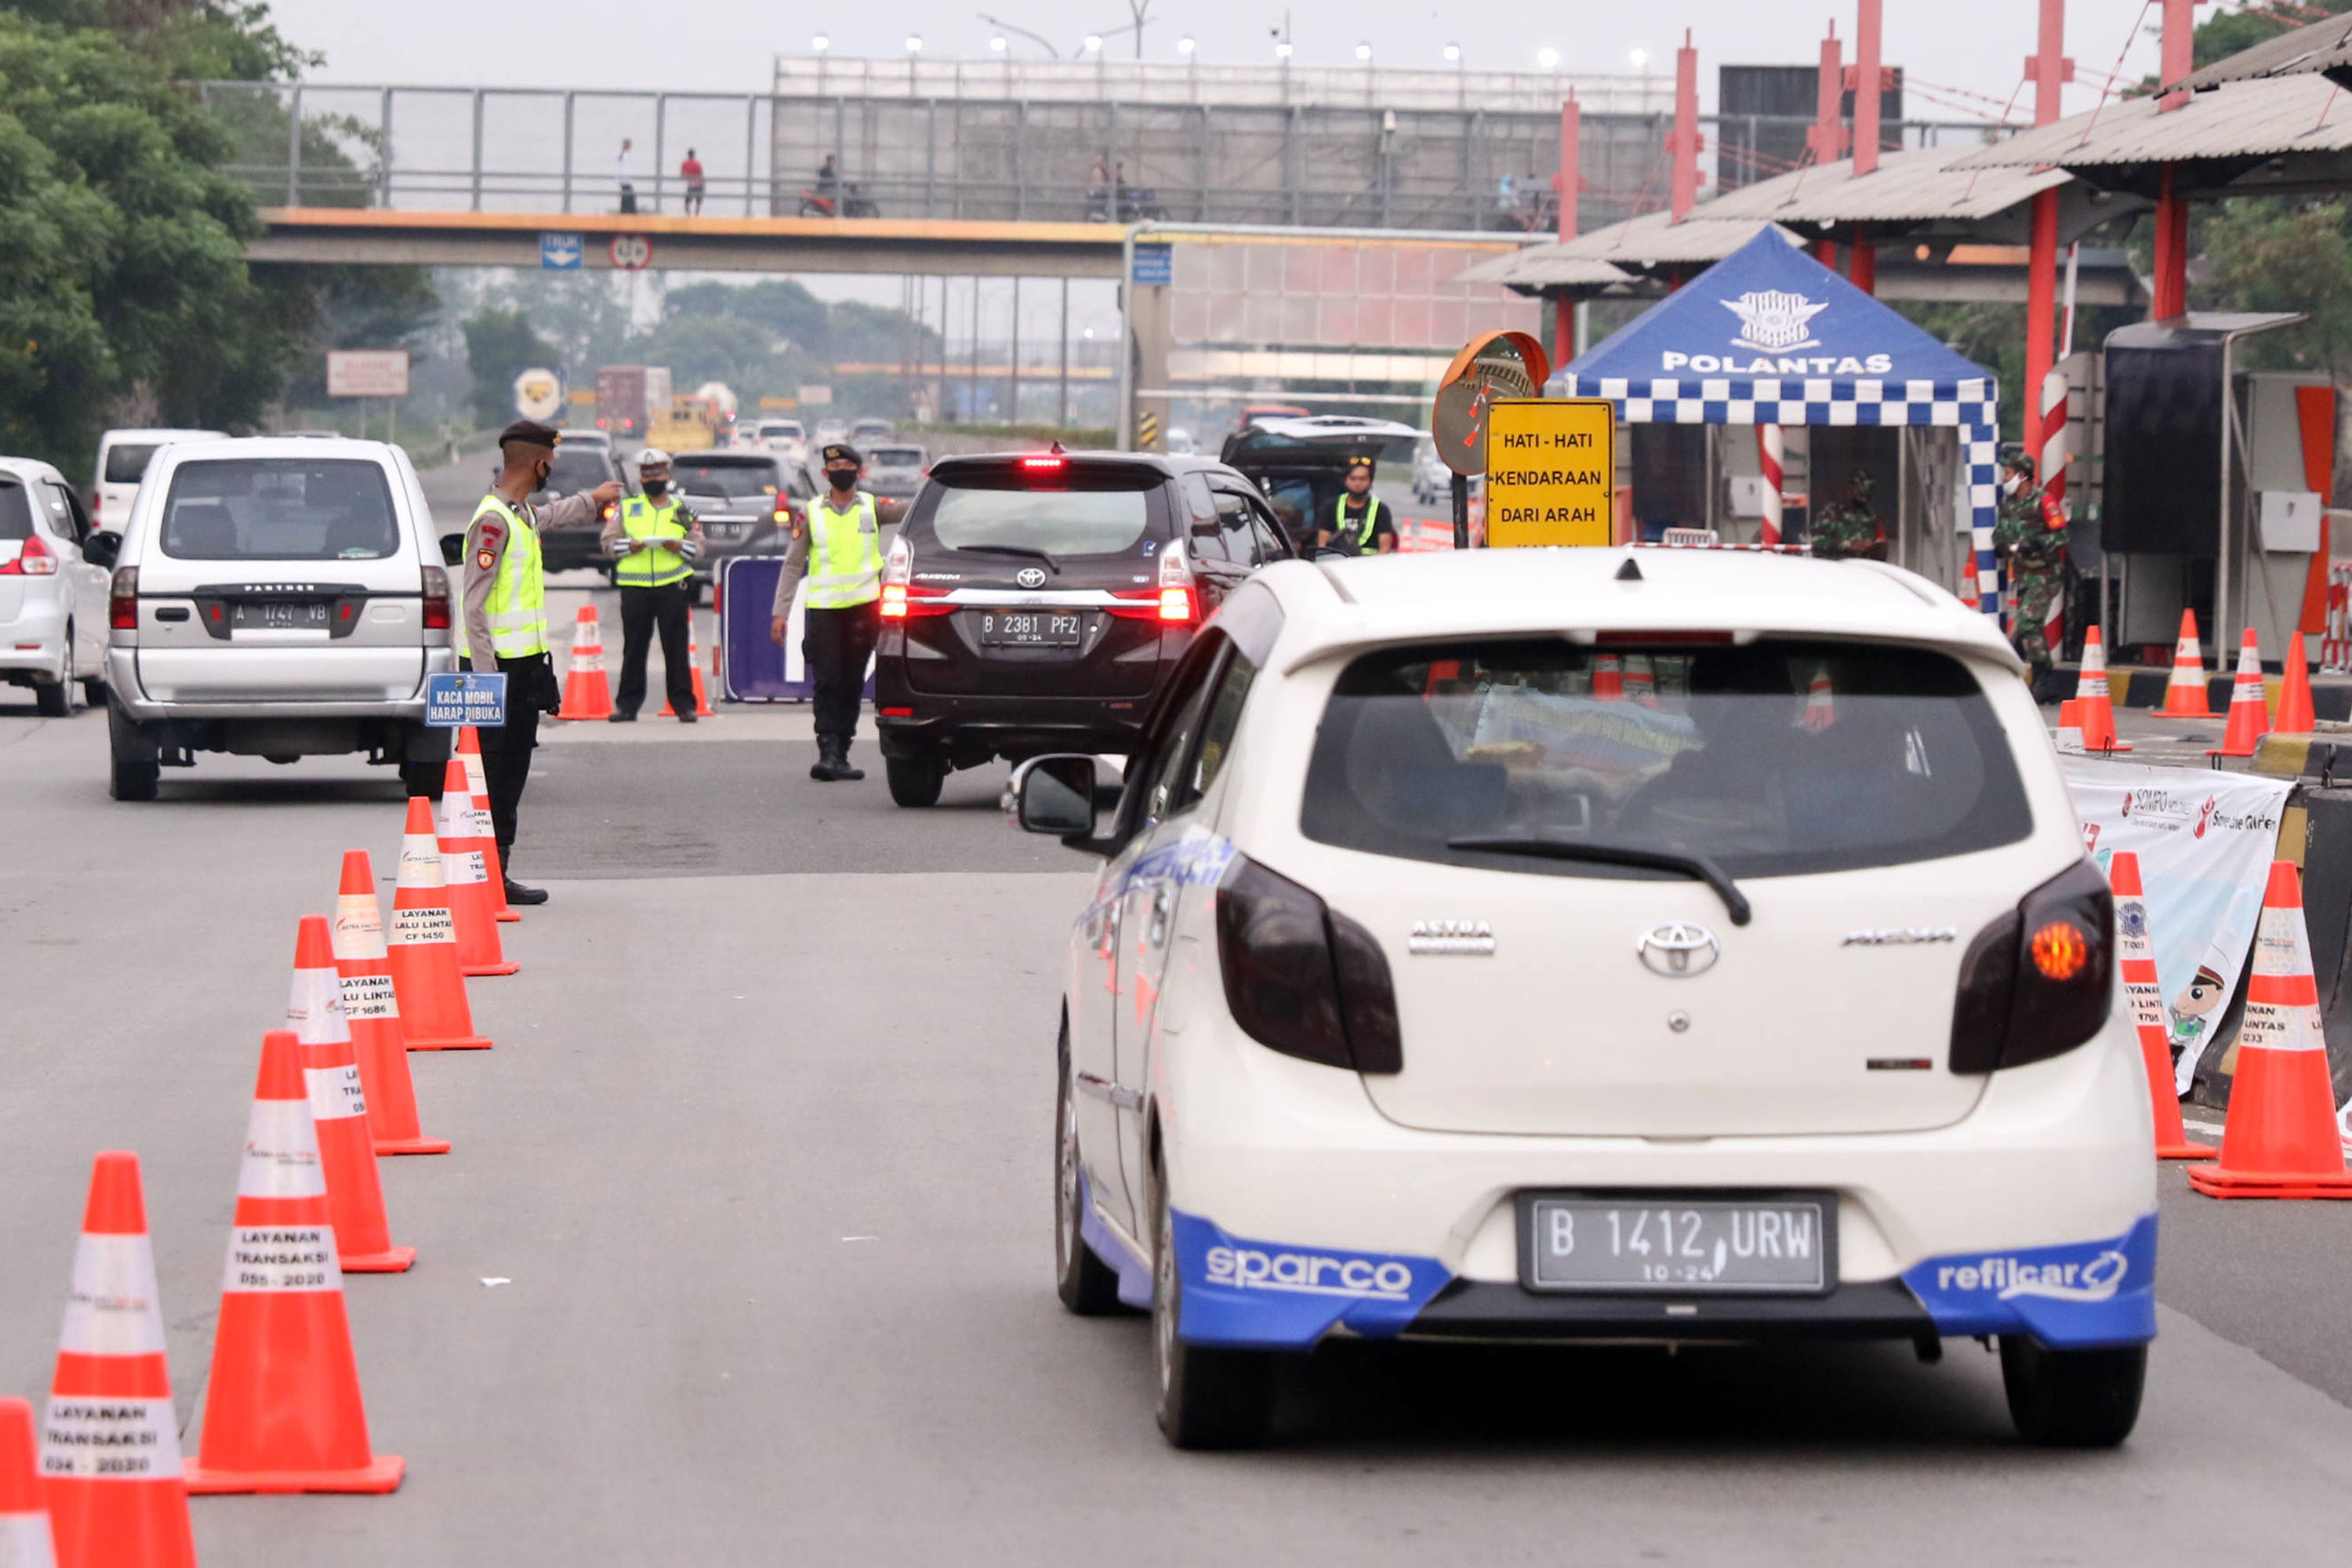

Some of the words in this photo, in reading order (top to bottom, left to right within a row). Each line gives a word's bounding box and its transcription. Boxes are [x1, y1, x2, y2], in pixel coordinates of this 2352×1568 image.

[1663, 350, 1893, 374] POLANTAS
[1504, 434, 1539, 448] HATI
[1555, 434, 1592, 448] HATI
[1495, 471, 1601, 485] KENDARAAN
[1501, 508, 1539, 522] DARI
[1544, 508, 1595, 522] ARAH
[236, 605, 245, 620] A
[985, 616, 993, 633] B
[1005, 616, 1037, 633] 2381
[1051, 616, 1077, 633] PFZ
[437, 691, 463, 704] KACA
[465, 691, 495, 704] MOBIL
[430, 706, 463, 720] HARAP
[466, 706, 501, 720] DIBUKA
[401, 909, 447, 918] LAYANAN
[339, 978, 390, 988] LAYANAN
[242, 1232, 320, 1243] LAYANAN
[1551, 1208, 1575, 1257] B
[1608, 1209, 1704, 1257] 1412
[1732, 1210, 1812, 1259] URW
[236, 1251, 328, 1265] TRANSAKSI
[1207, 1246, 1412, 1292] sparco
[1938, 1258, 2079, 1290] refilcar
[54, 1406, 147, 1421] LAYANAN
[48, 1431, 157, 1446] TRANSAKSI
